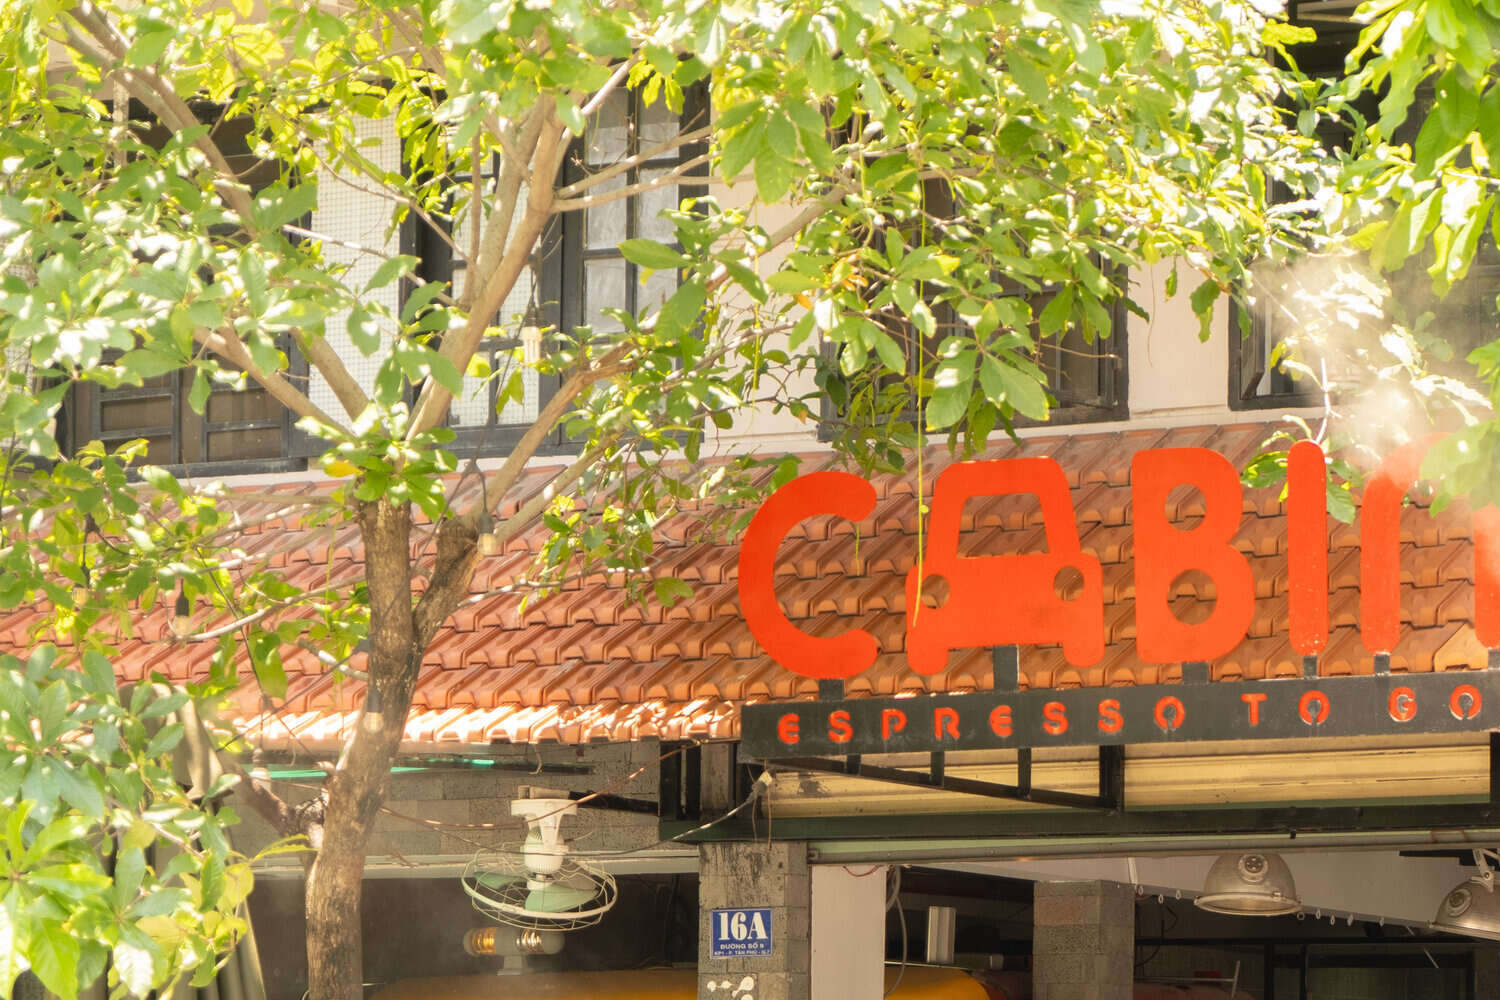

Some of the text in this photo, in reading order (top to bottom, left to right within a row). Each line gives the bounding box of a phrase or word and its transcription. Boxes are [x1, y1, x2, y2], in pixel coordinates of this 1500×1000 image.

[777, 684, 1484, 745] ESPRESSO TO GO
[719, 911, 768, 941] 16A
